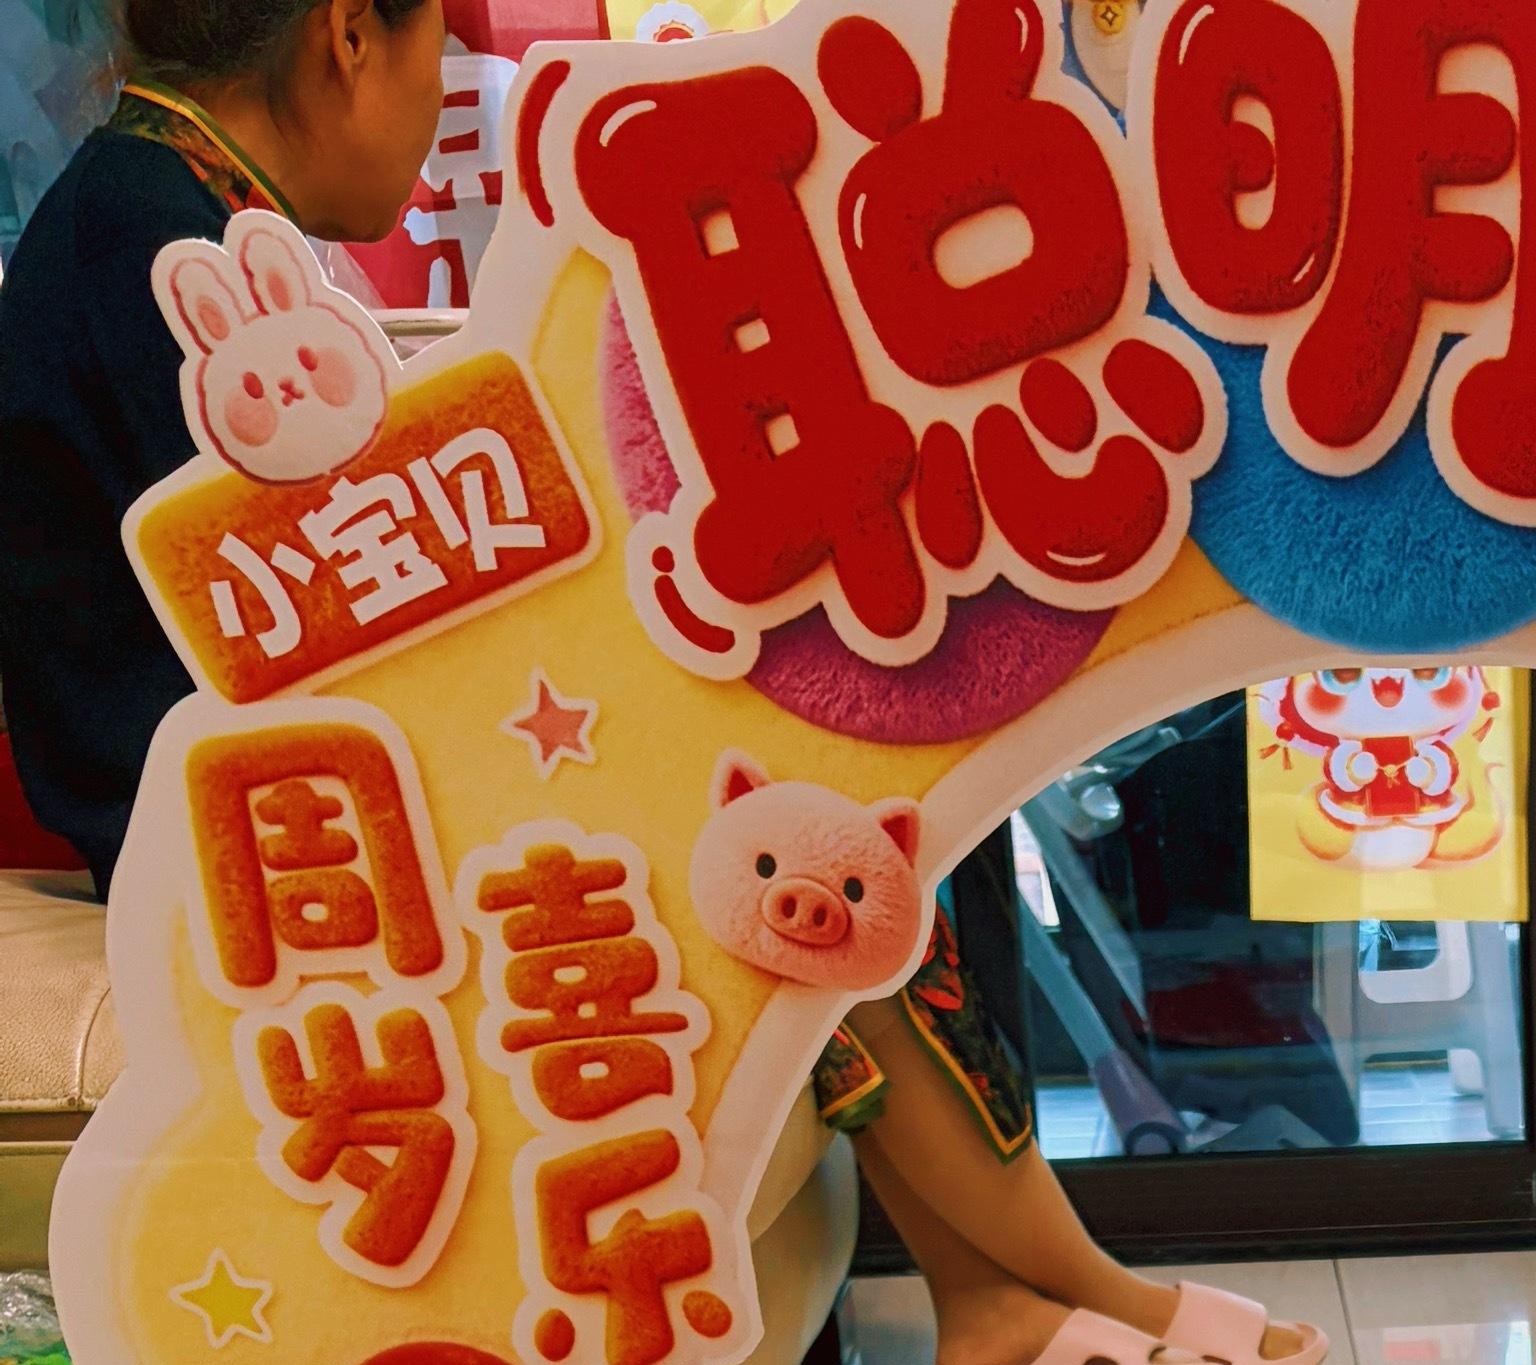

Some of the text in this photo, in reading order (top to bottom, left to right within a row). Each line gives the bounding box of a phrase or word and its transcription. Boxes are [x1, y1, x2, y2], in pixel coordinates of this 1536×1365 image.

[210, 427, 546, 660] 小宝贝
[186, 721, 456, 1268] 周岁
